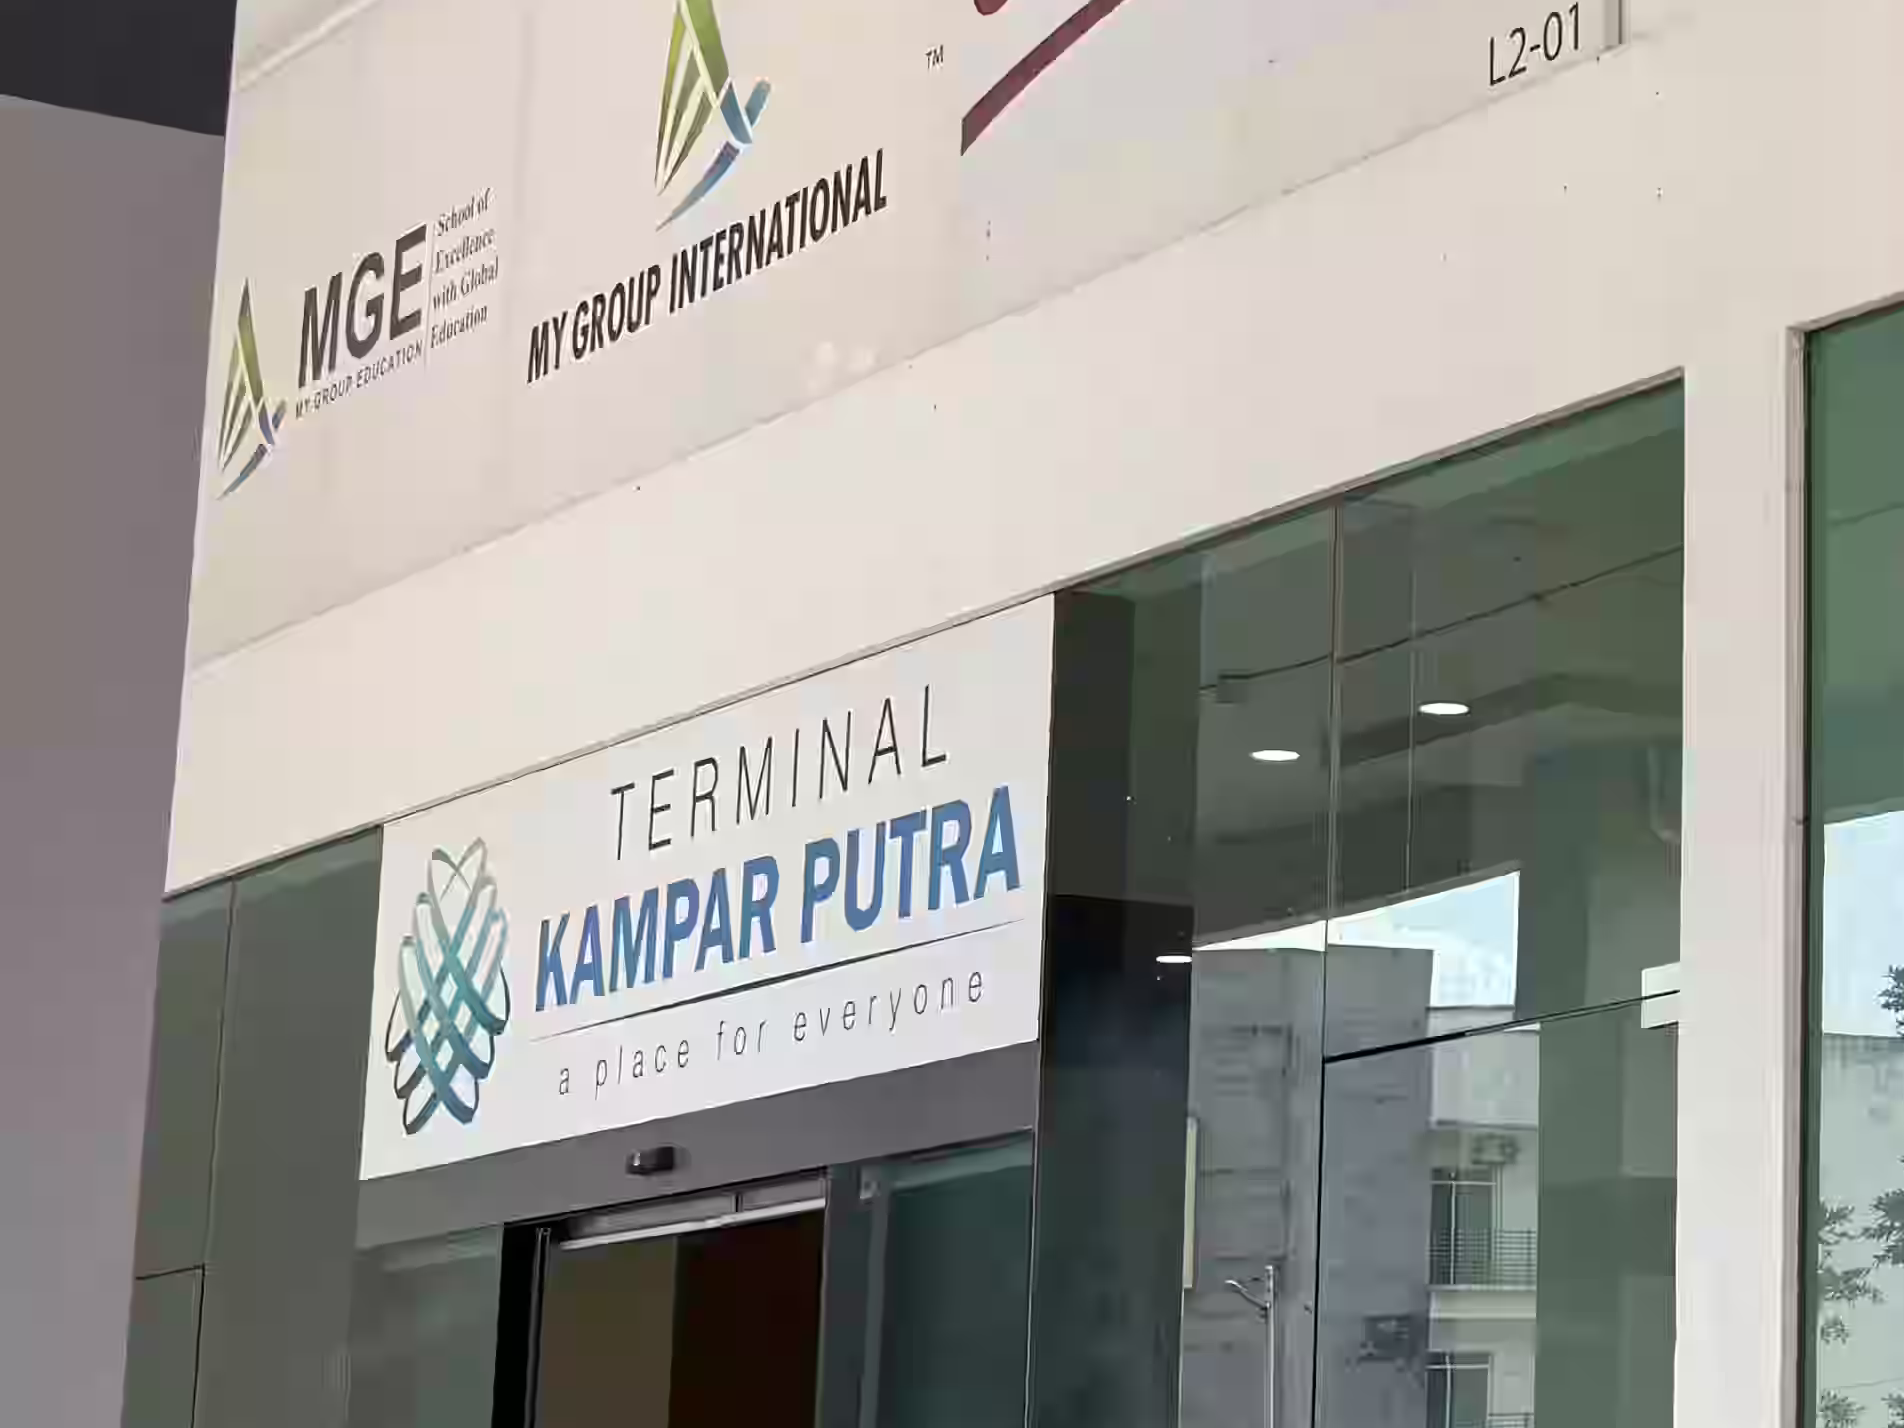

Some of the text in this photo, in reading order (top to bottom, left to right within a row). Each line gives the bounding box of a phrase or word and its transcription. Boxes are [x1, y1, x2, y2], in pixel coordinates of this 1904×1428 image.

[1489, 1, 1580, 86] L2-01
[434, 228, 495, 274] Excellence
[436, 187, 492, 237] School of
[297, 222, 428, 388] MGE
[432, 255, 499, 310] with Global
[527, 148, 888, 384] MY GROUP INTERNATIONAL
[430, 305, 488, 349] Education
[295, 338, 423, 420] MY GROUP EDUCATION
[610, 684, 948, 860] TERMINAL
[535, 785, 1021, 1013] KAMPAR PUTRA
[557, 969, 984, 1100] a place for everyone
